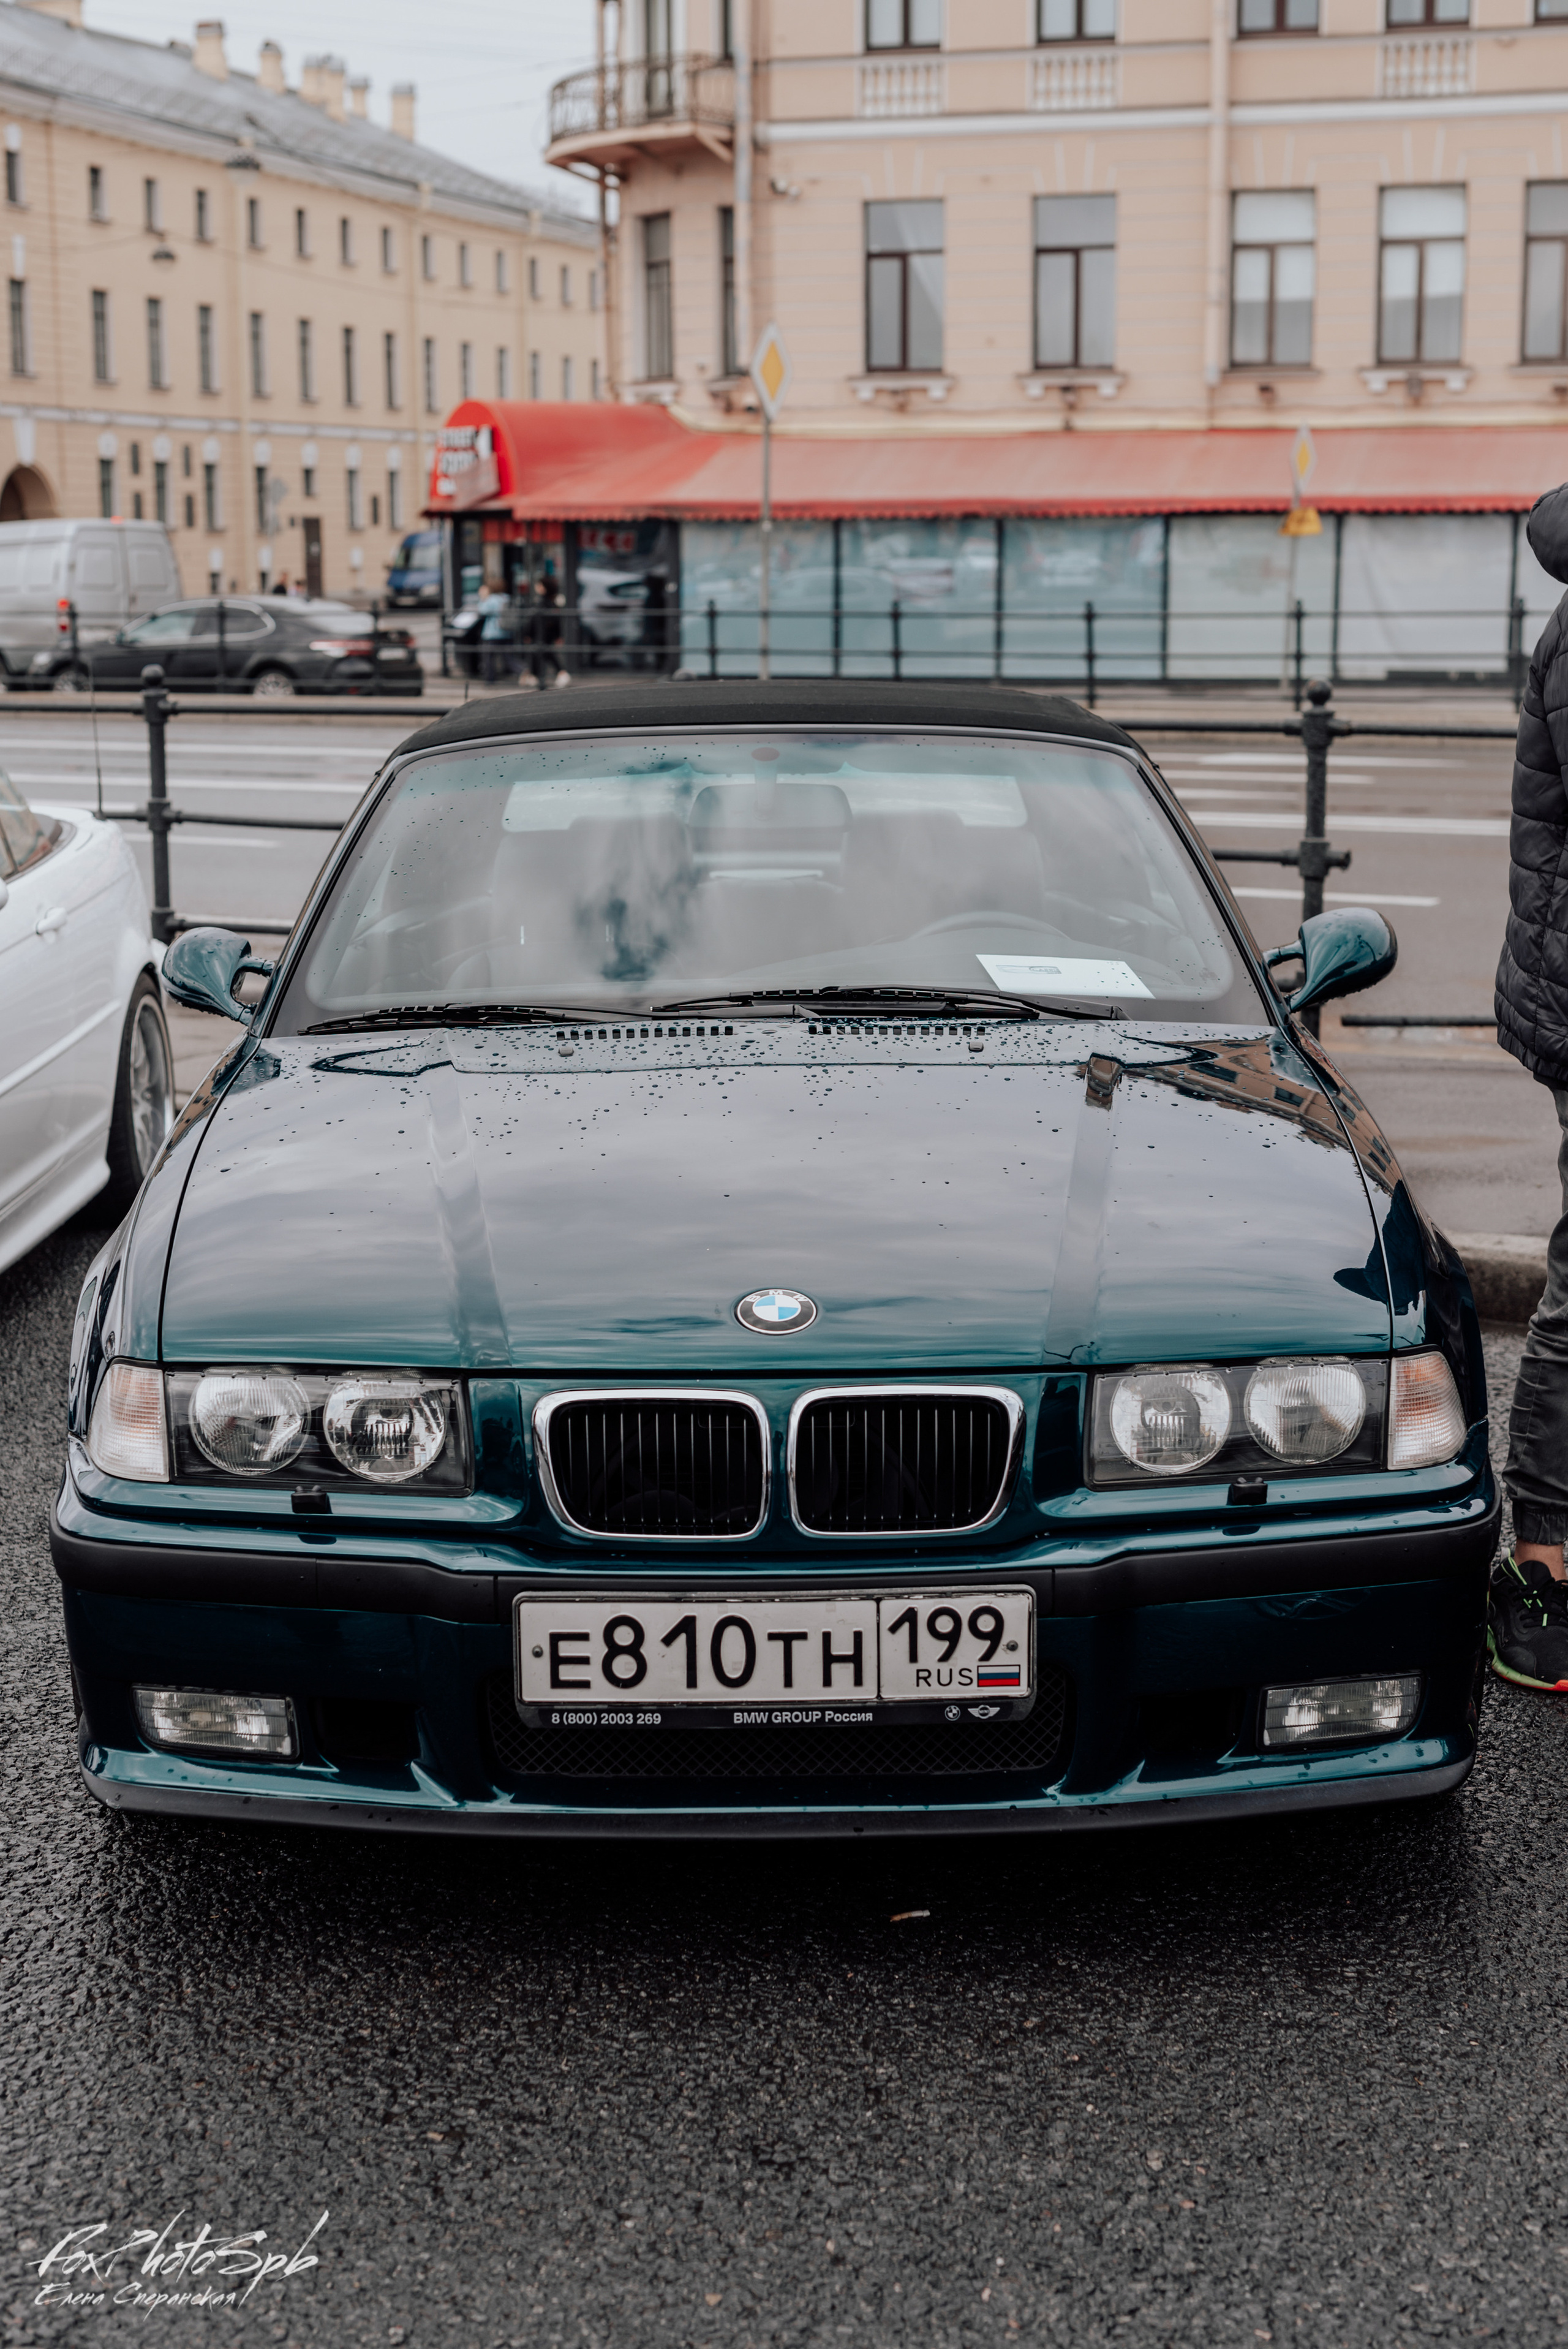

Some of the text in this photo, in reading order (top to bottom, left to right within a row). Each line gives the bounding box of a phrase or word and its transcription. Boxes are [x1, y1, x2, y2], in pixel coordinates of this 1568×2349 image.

[745, 1290, 809, 1303] BMW
[887, 1605, 1005, 1664] 199
[916, 1666, 974, 1688] RUS
[551, 1711, 662, 1725] 8 (800) 2003 269
[733, 1711, 873, 1724] BMW GROUP Россия
